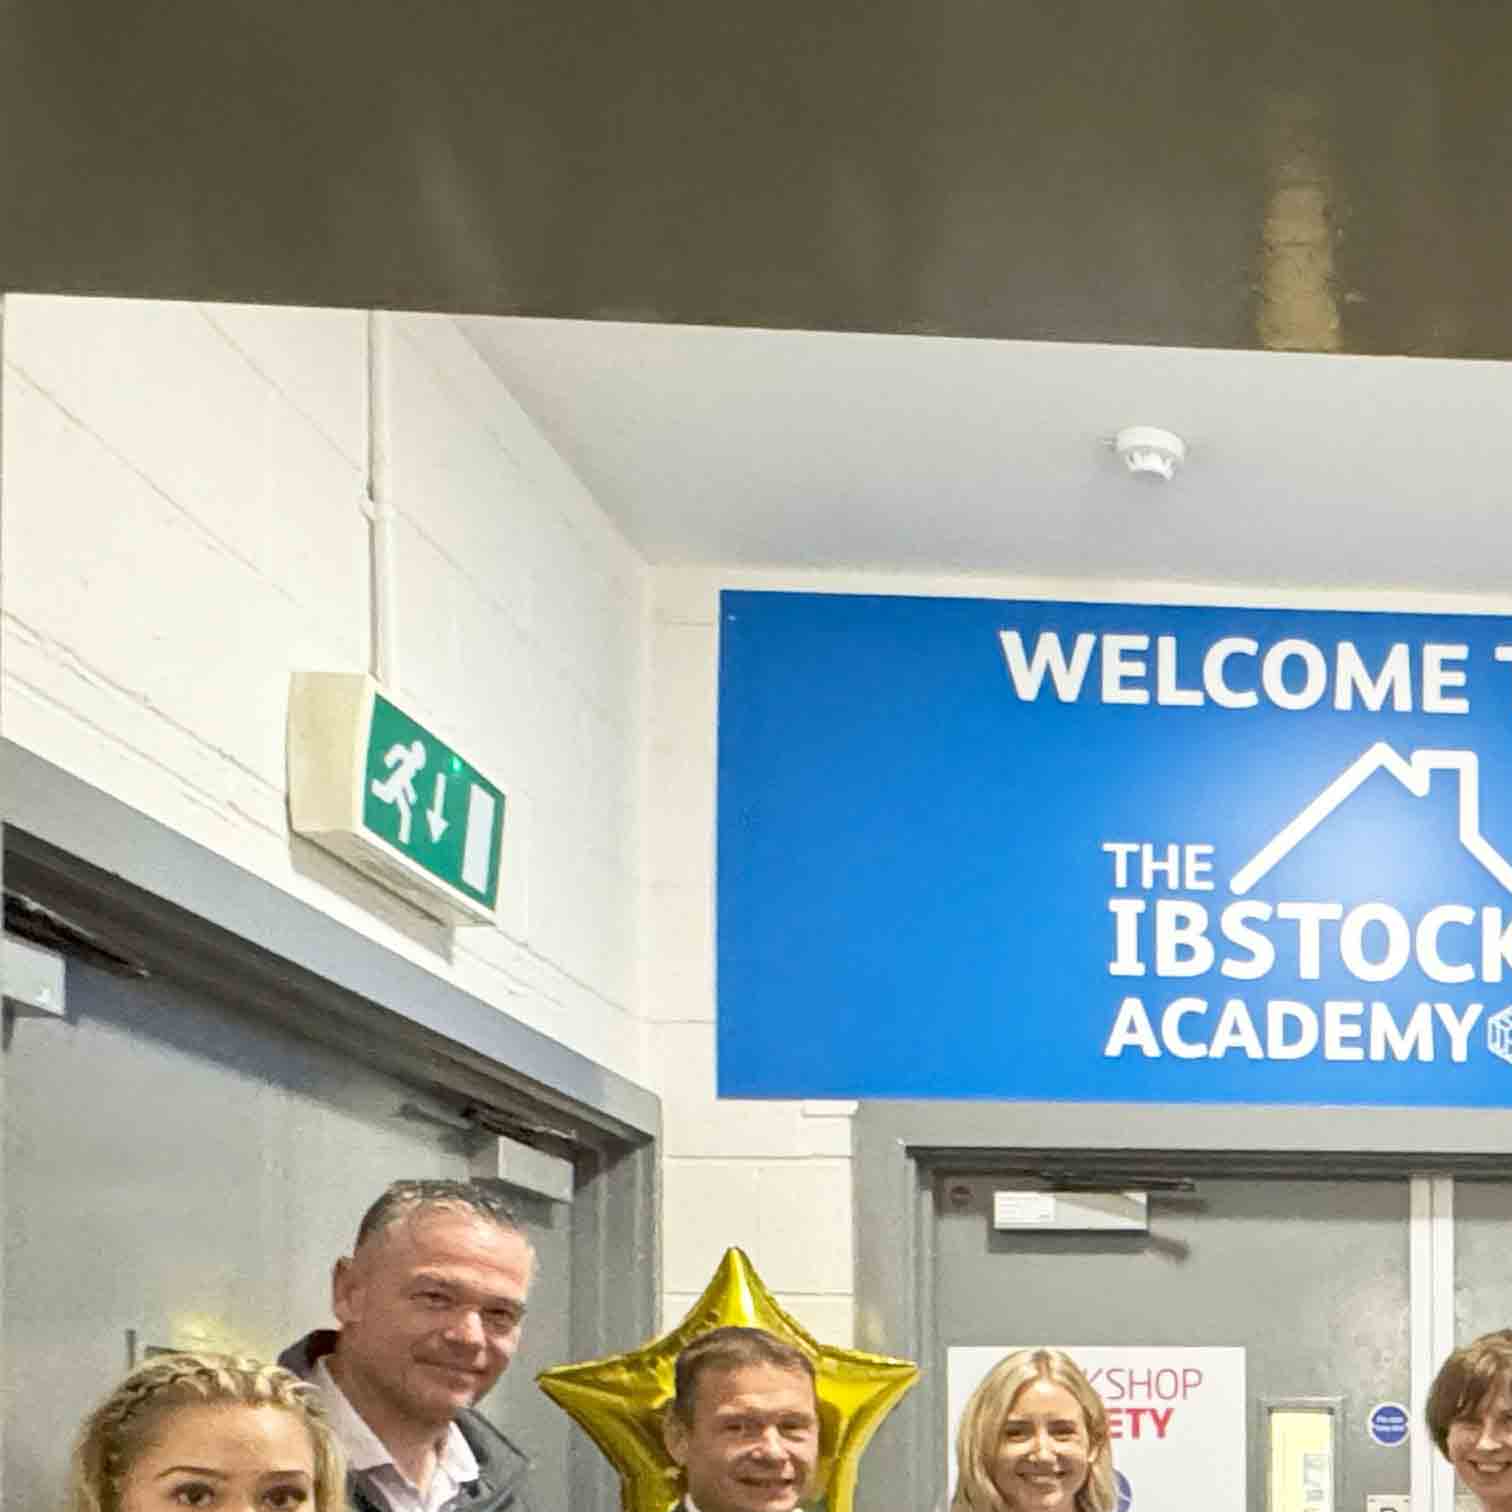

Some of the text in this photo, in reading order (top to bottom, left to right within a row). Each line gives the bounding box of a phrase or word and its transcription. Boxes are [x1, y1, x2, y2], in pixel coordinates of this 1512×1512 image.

[999, 630, 1470, 715] WELCOME
[1103, 842, 1216, 891] THE
[1105, 997, 1485, 1065] ACADEMY
